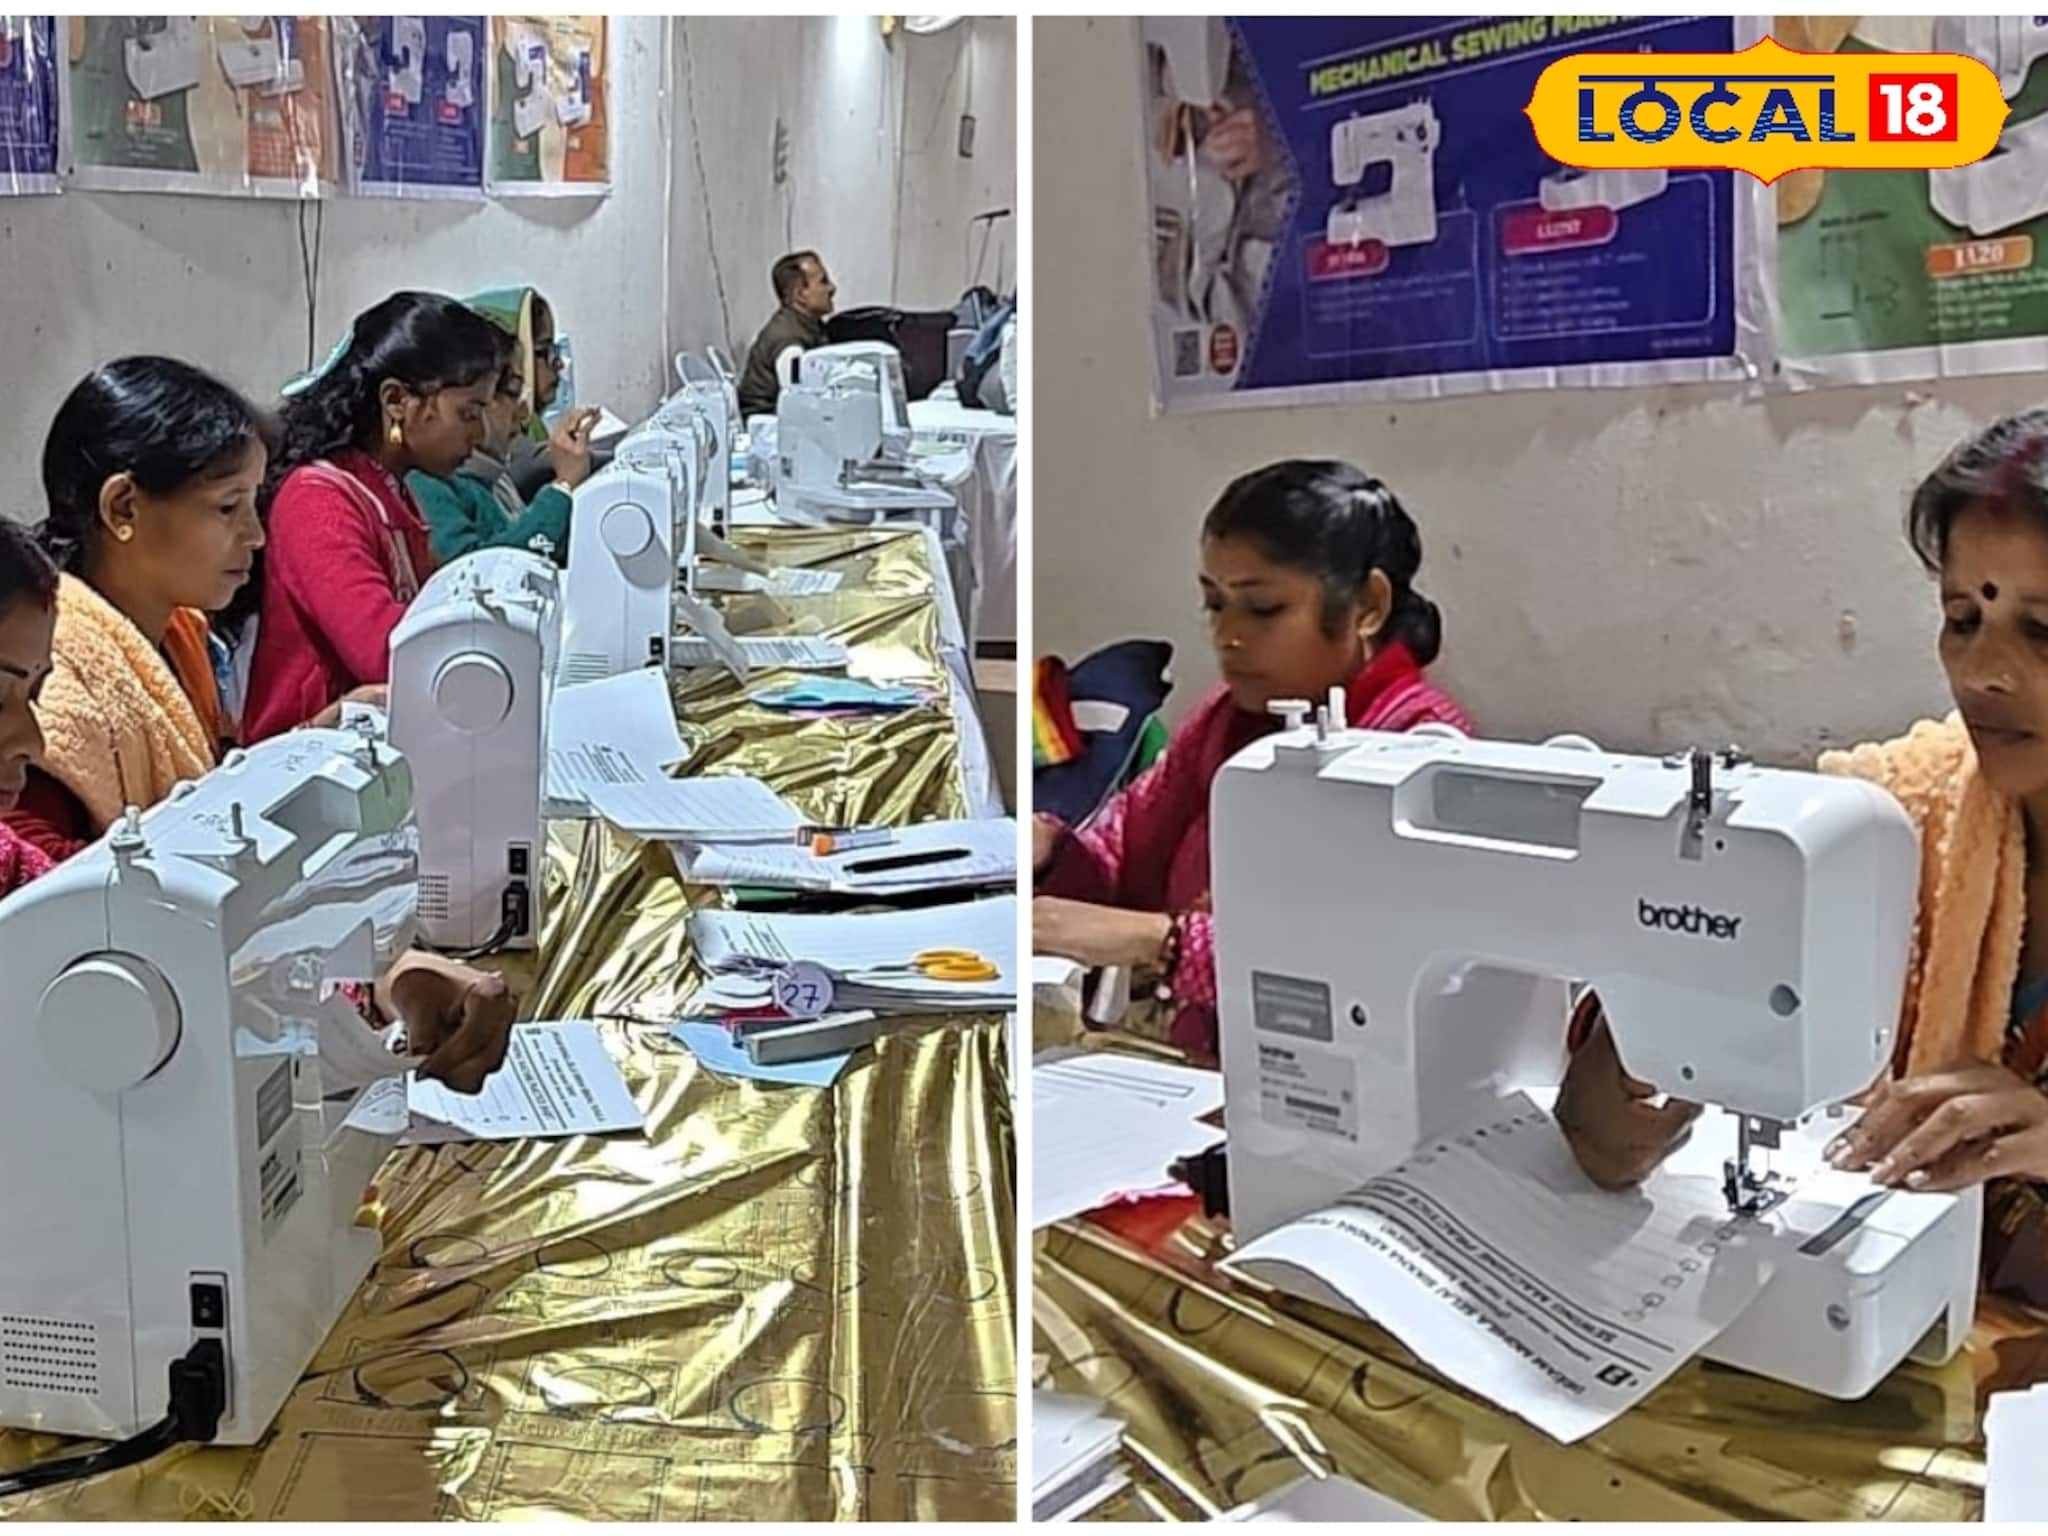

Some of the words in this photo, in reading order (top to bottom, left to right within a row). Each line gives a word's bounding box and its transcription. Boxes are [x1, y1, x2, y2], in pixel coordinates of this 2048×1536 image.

[1310, 39, 1448, 96] MECHANICAL
[1451, 16, 1549, 61] SEWING
[1638, 898, 1742, 940] brother
[784, 983, 820, 1009] 27
